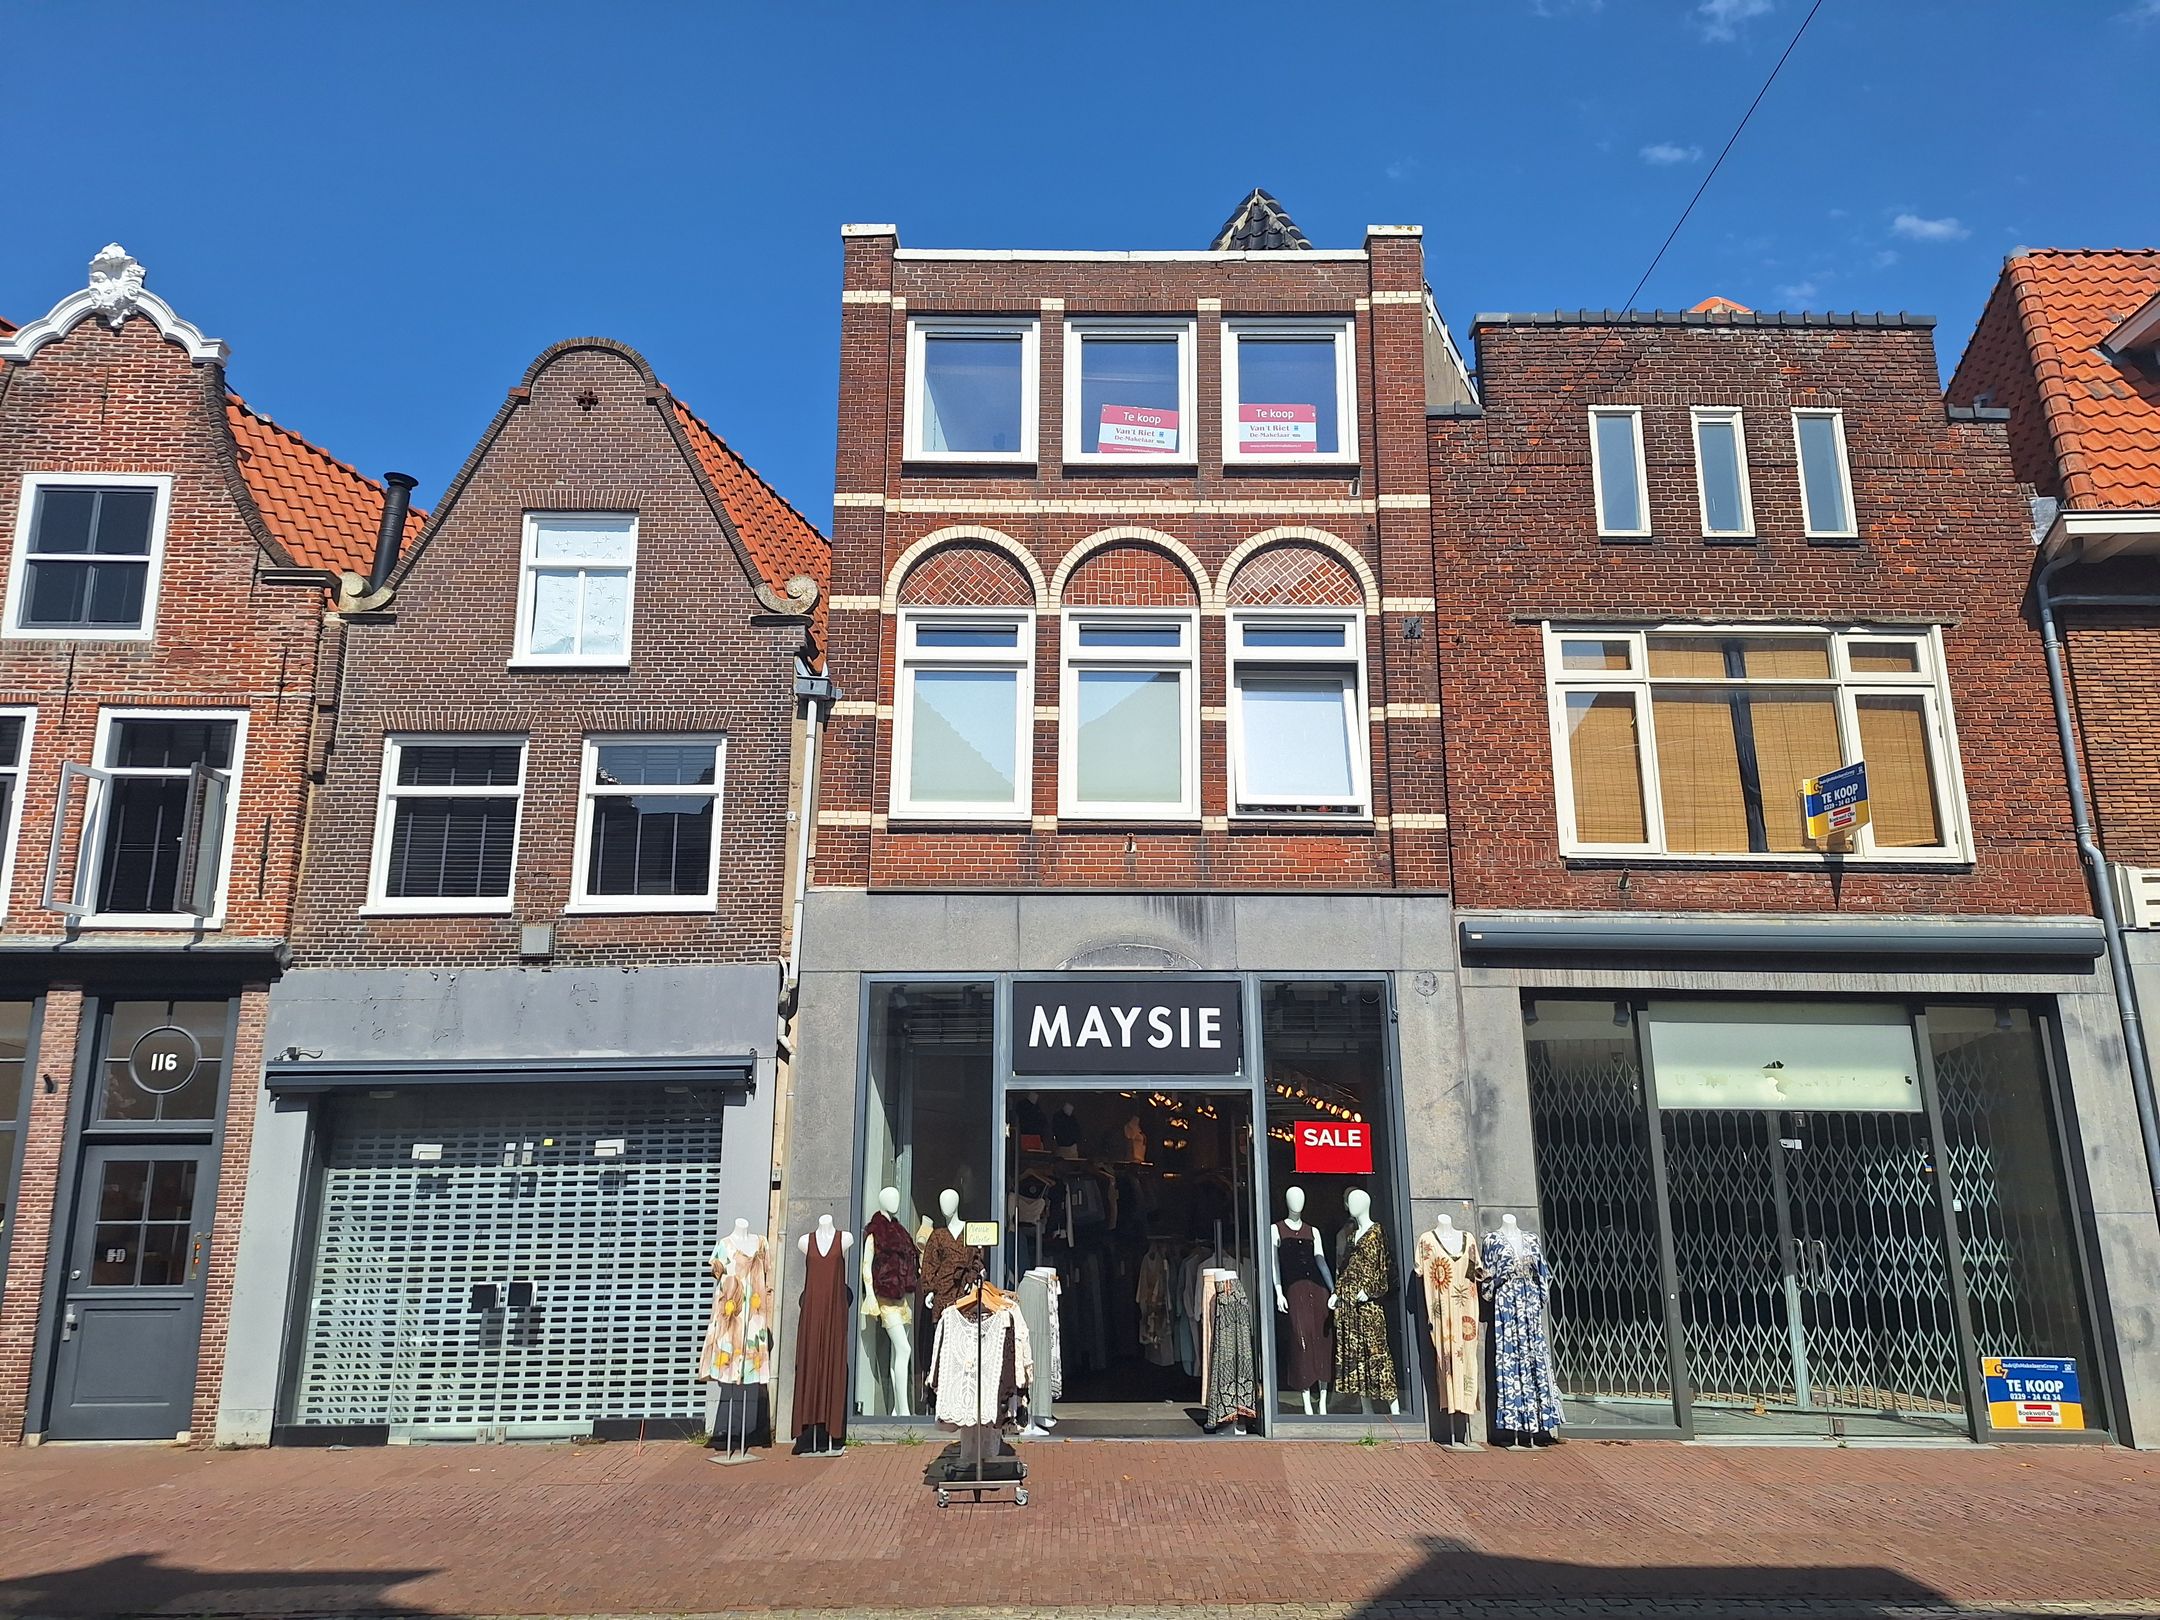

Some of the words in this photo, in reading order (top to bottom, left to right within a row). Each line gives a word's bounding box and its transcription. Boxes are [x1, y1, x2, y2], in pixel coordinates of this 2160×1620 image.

[1123, 411, 1135, 421] Te
[1137, 413, 1161, 426] koop
[1255, 408, 1268, 418] Te
[1270, 409, 1294, 420] koop
[1138, 429, 1155, 437] Riet
[1821, 792, 1832, 804] TE
[1834, 783, 1859, 801] KOOP
[1029, 1005, 1221, 1049] MAYSIE
[151, 1053, 178, 1071] 116
[1303, 1128, 1362, 1147] SALE
[2006, 1379, 2022, 1392] TE
[2025, 1380, 2064, 1393] KOOP
[2042, 1393, 2050, 1401] 42
[2052, 1393, 2061, 1401] 34
